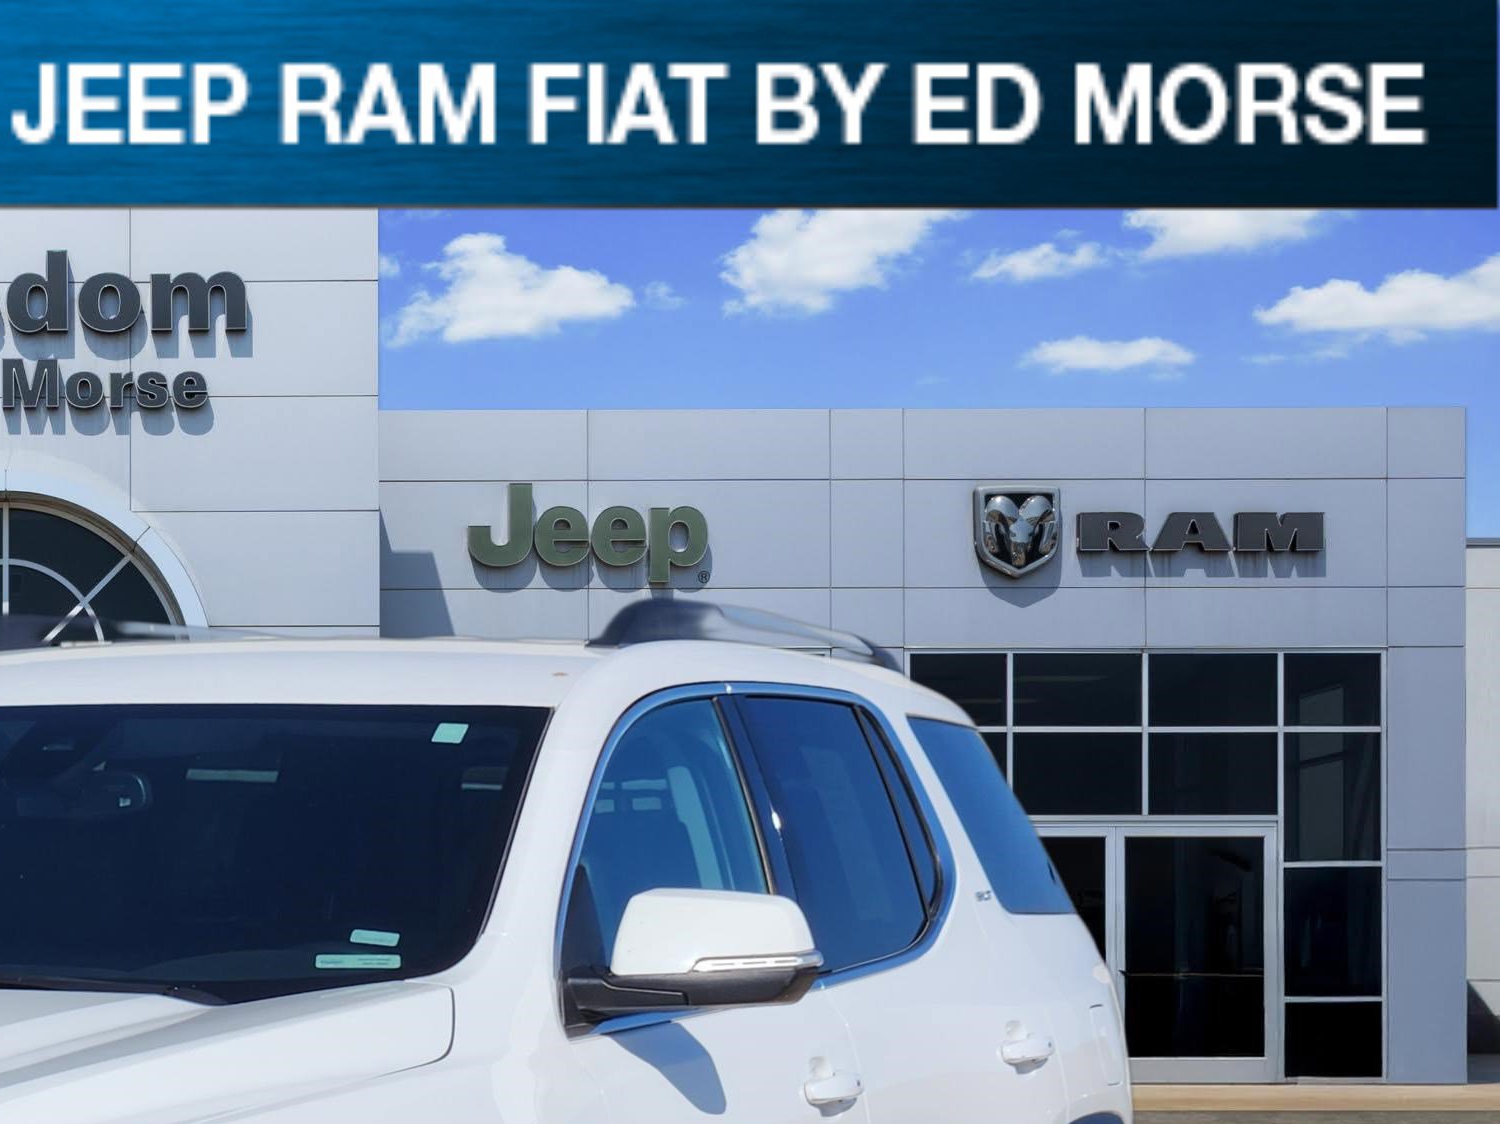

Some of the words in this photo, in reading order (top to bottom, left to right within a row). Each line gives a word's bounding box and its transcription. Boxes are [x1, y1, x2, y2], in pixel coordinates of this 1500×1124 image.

[2, 358, 209, 410] Morse
[467, 482, 709, 584] Jeep
[1075, 511, 1326, 553] RAM
